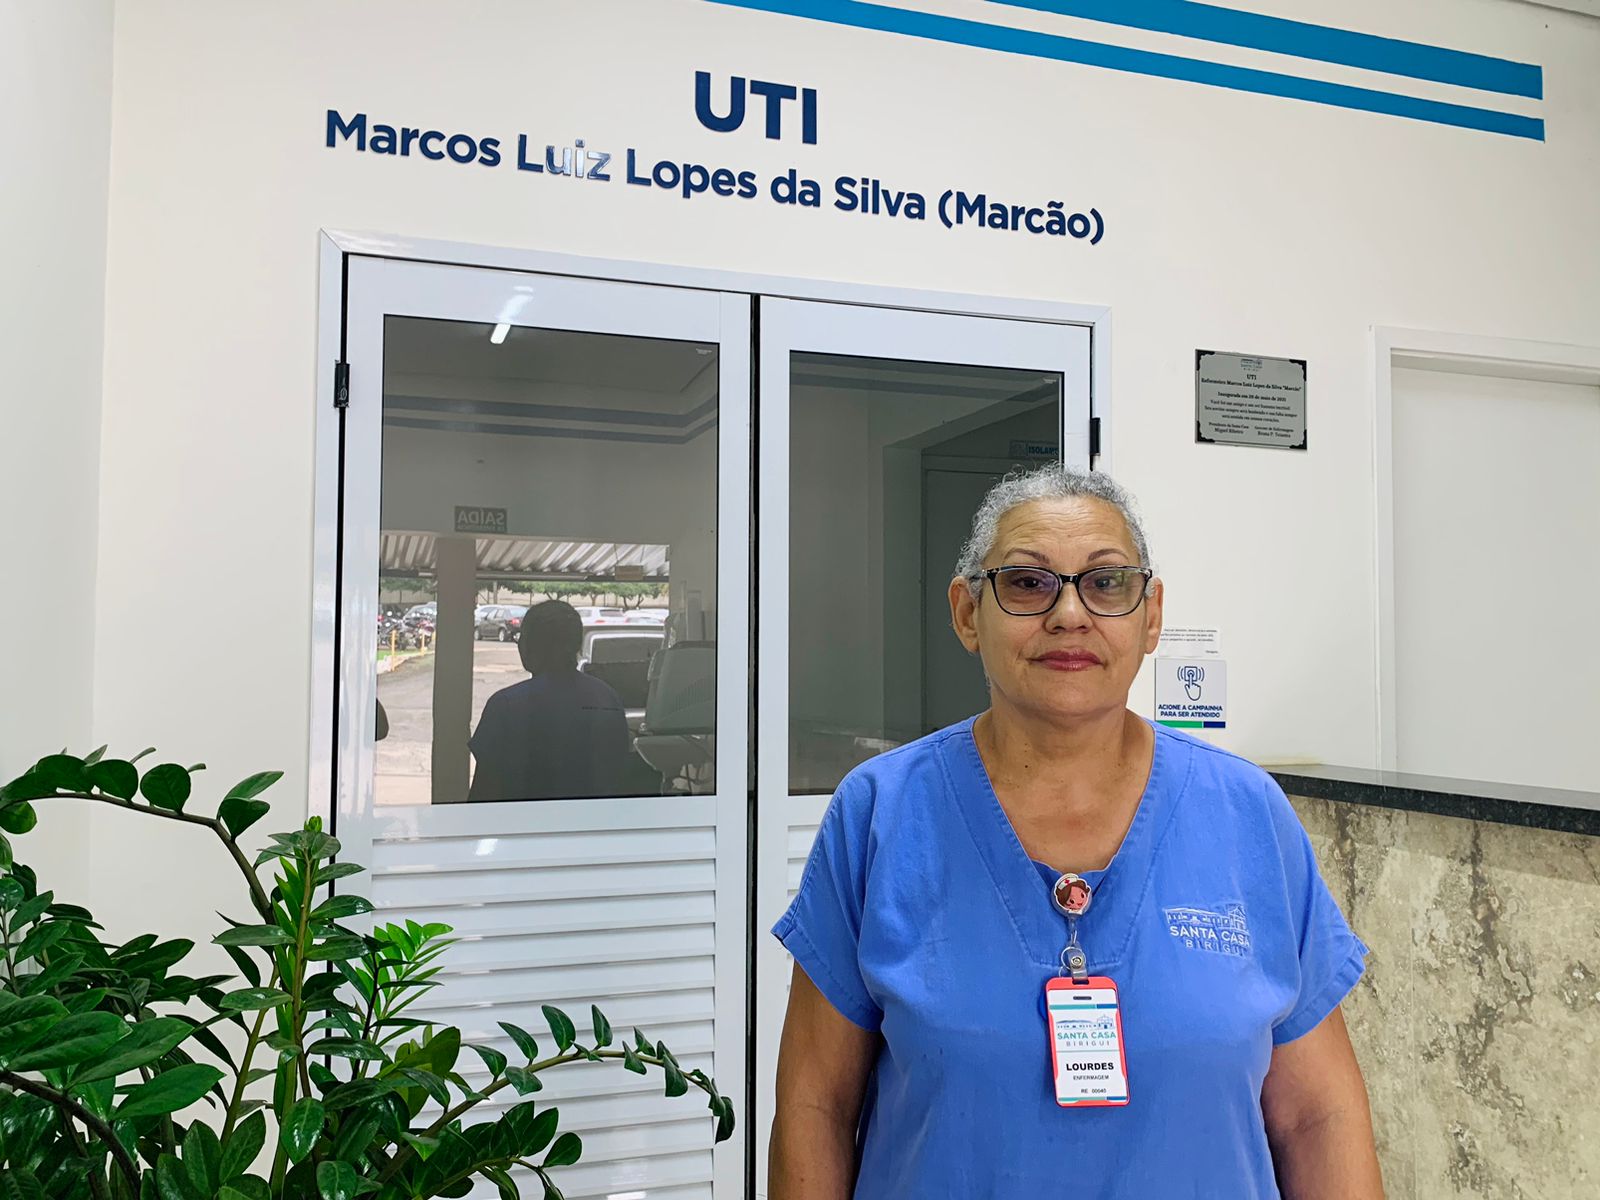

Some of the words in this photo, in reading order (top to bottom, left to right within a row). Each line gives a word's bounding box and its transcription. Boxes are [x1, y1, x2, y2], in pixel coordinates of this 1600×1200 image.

[694, 71, 817, 145] UTI
[326, 109, 501, 167] Marcos
[517, 134, 611, 182] Luiz
[626, 148, 758, 199] Lopes
[770, 169, 821, 207] da
[834, 176, 926, 220] Silva
[938, 189, 1105, 245] (Marcão)
[1169, 925, 1218, 941] SANTA
[1221, 931, 1250, 948] CASA
[1057, 1032, 1088, 1040] SANTA
[1091, 1031, 1116, 1039] CASA
[1066, 1062, 1115, 1071] LOURDES
